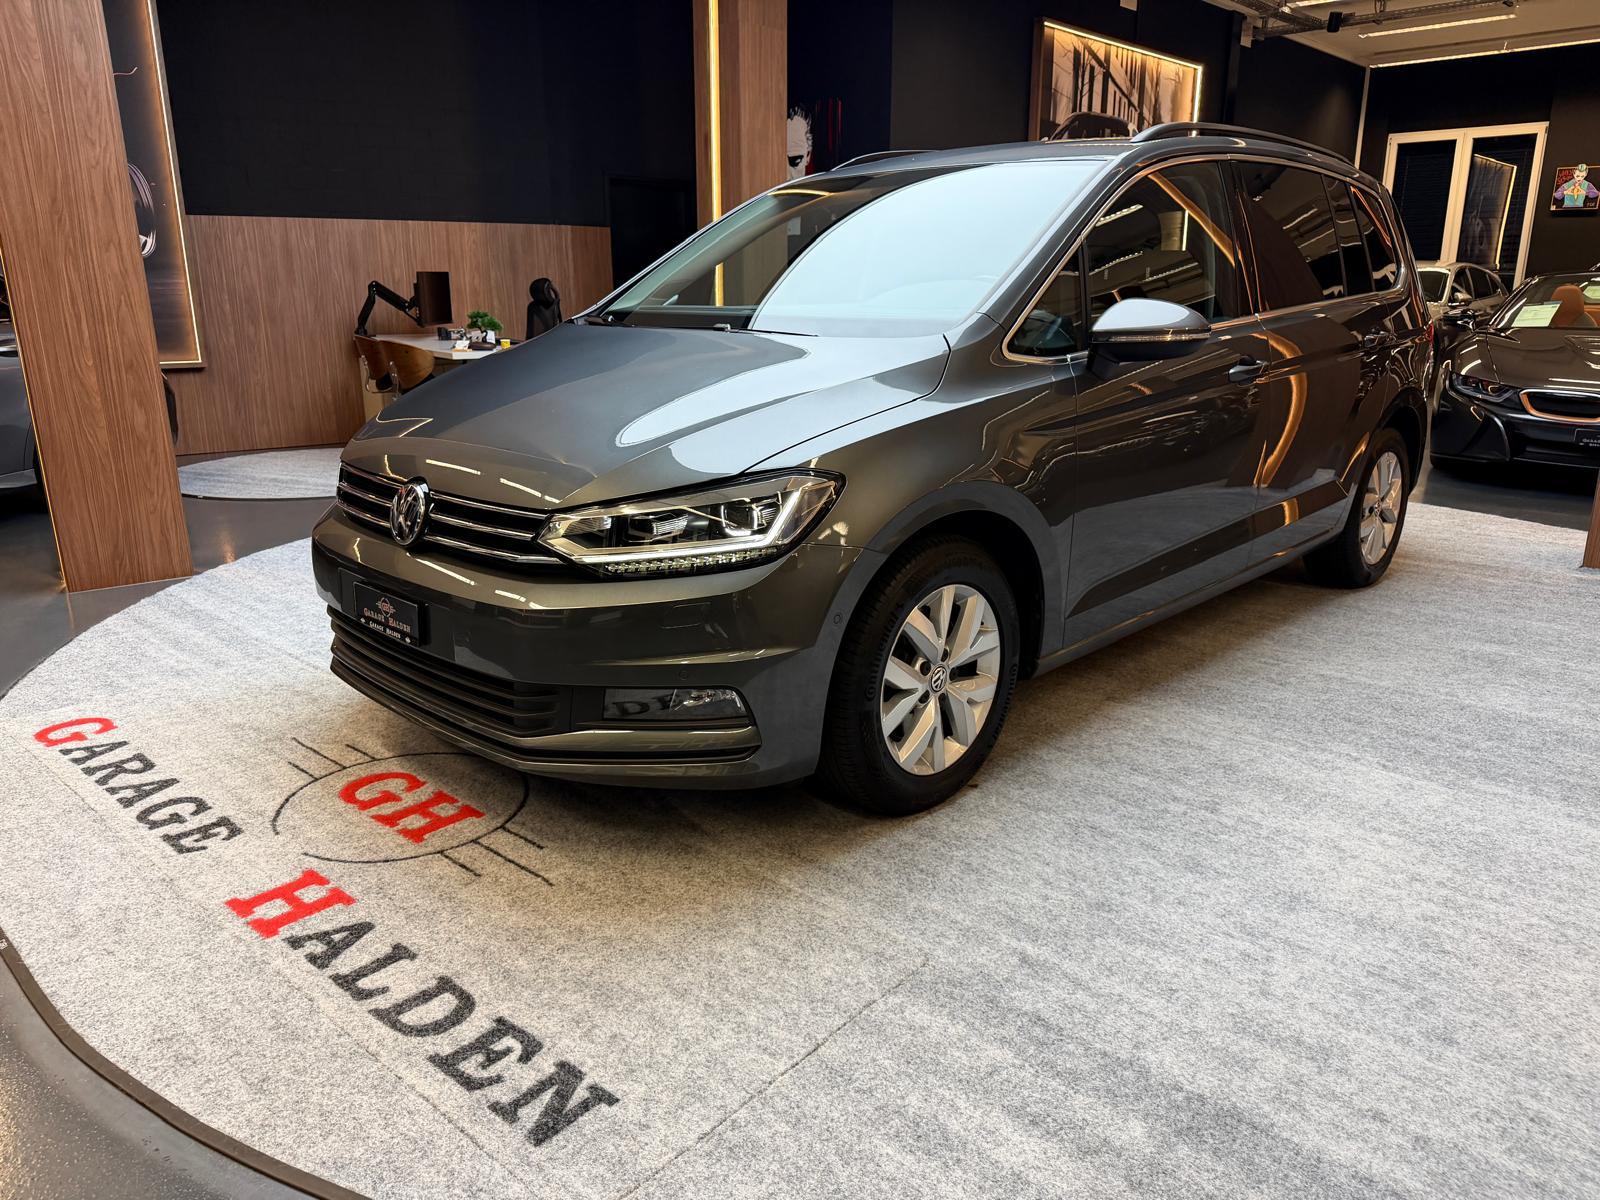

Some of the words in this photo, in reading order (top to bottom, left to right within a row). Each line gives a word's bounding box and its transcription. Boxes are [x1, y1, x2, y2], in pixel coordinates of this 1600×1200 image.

[34, 717, 242, 856] GARAGE
[224, 869, 619, 1147] HALDEN
[338, 771, 485, 845] GH
